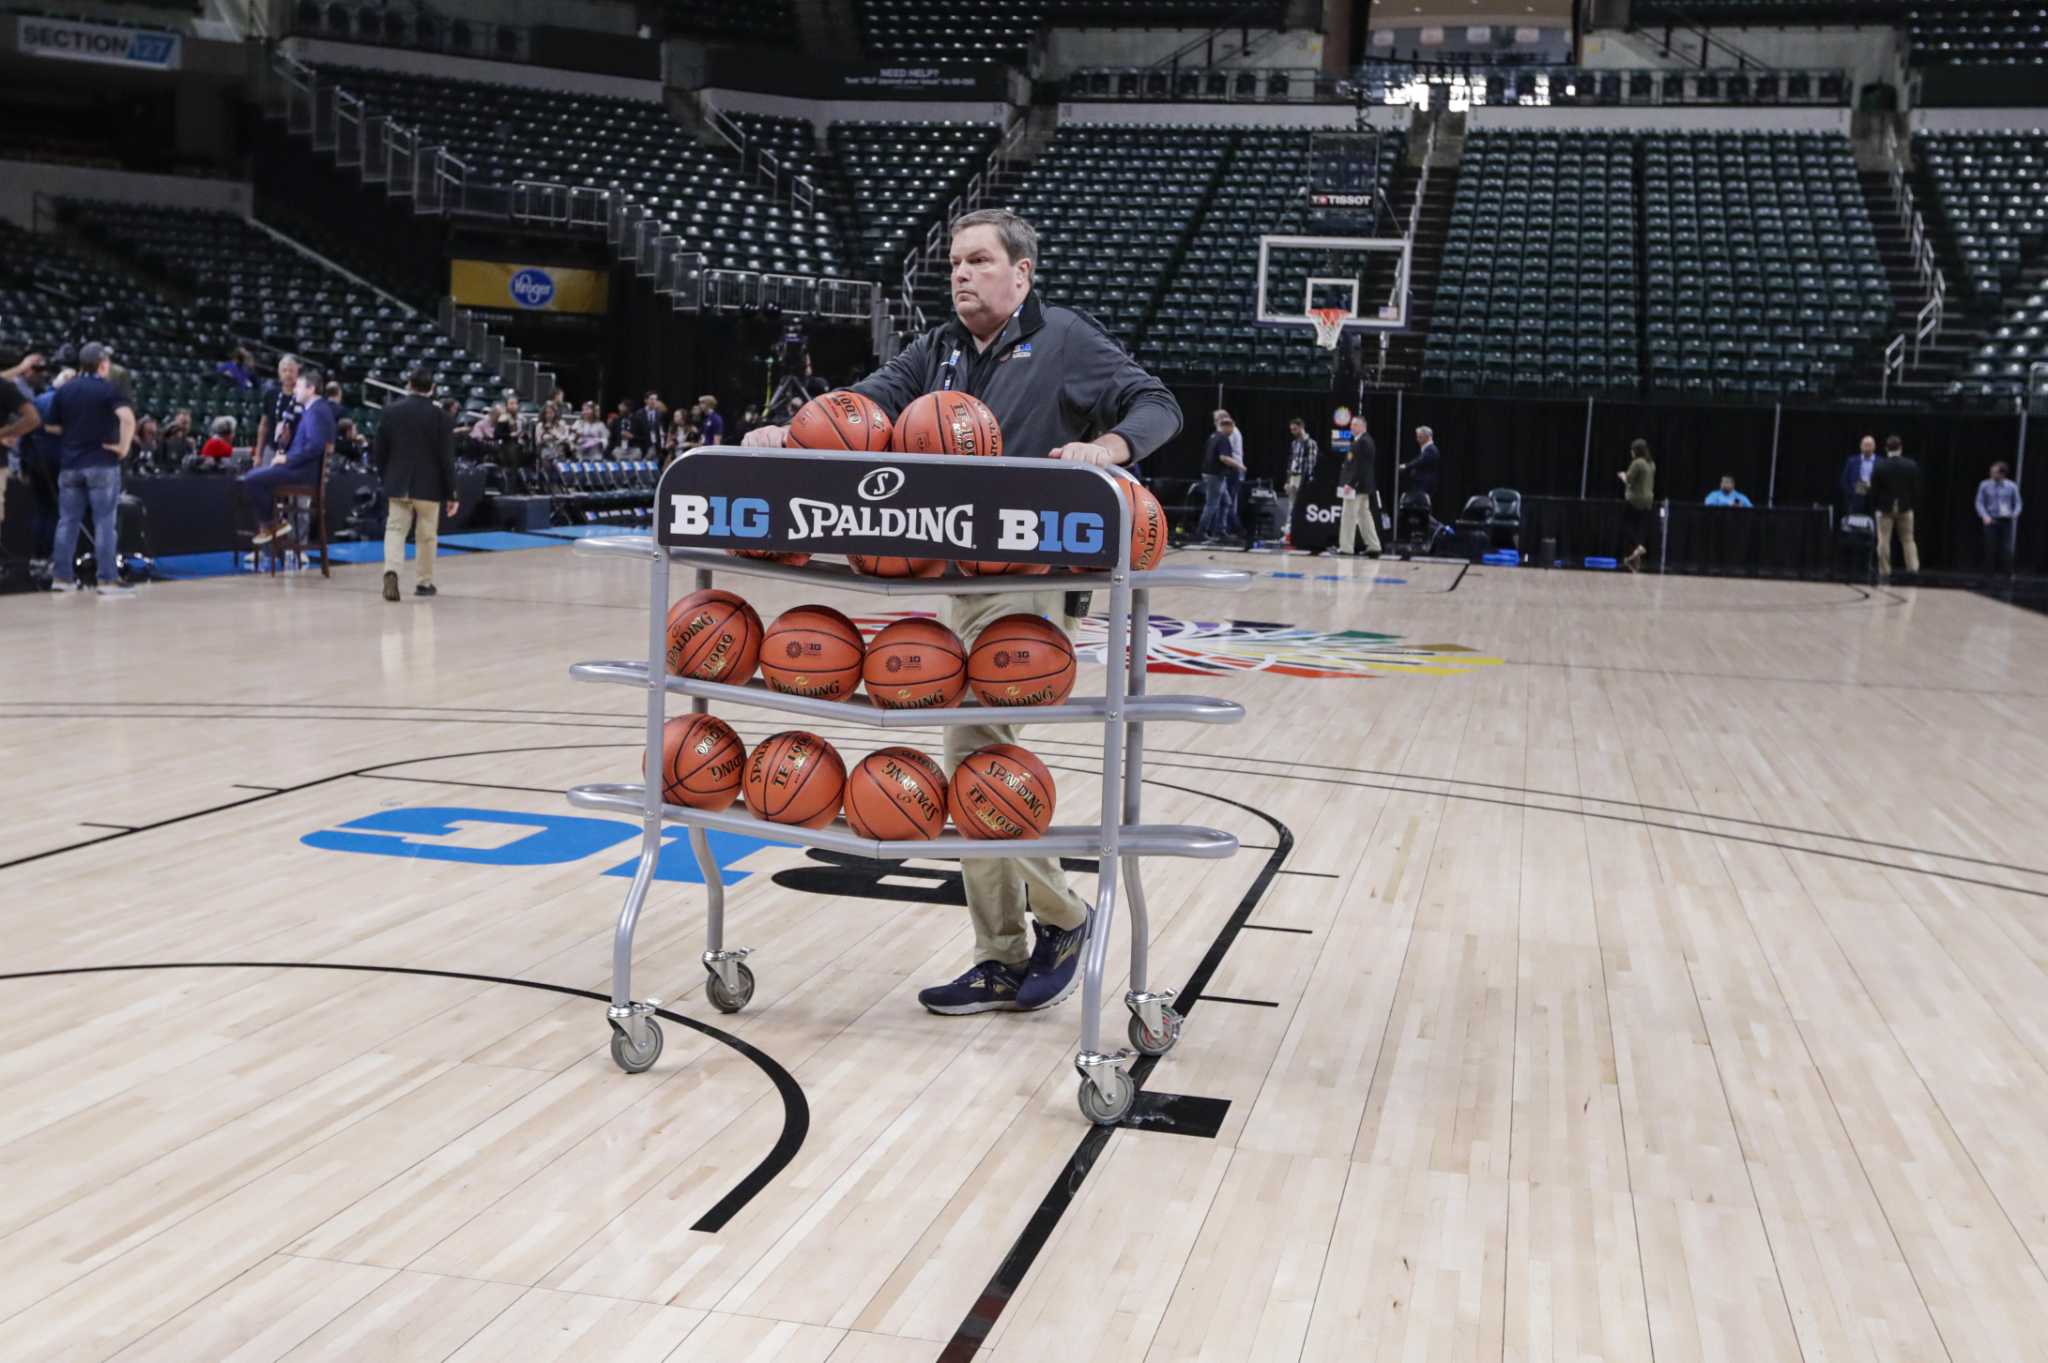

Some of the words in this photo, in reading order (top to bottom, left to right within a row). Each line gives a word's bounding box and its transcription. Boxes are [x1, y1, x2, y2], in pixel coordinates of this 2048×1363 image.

[22, 24, 129, 53] SECTION
[1328, 195, 1372, 205] TISSOT
[514, 274, 551, 303] Kroger
[788, 497, 974, 549] SPALDING
[985, 761, 1045, 819] SPALDING
